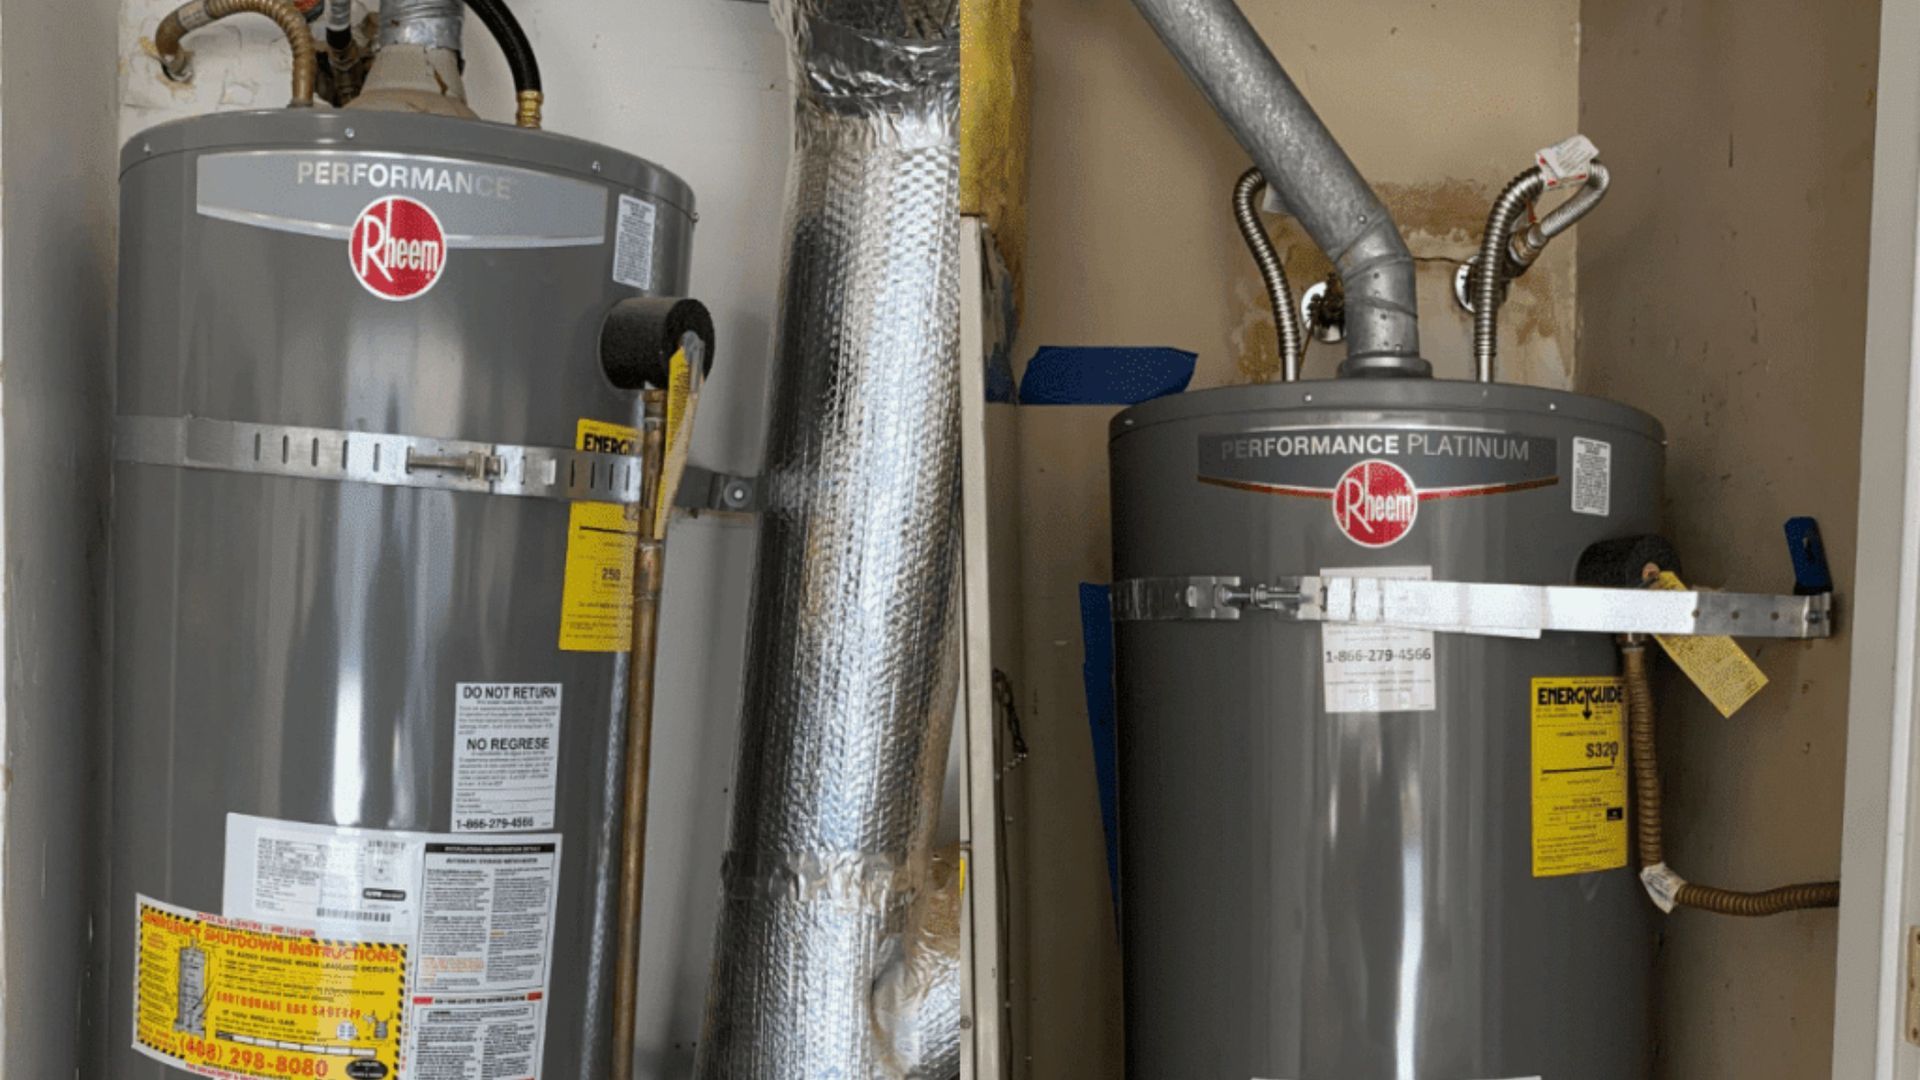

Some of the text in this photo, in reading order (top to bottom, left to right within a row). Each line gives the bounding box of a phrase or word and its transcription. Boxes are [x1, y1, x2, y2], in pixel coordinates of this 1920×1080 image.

[297, 161, 512, 200] PERFORMANCE
[359, 199, 439, 282] Rheem
[1221, 434, 1529, 461] PERFORMANCE PLATINUM
[1342, 464, 1413, 533] Rheem
[463, 685, 557, 699] DO NOT RETURN
[1538, 686, 1624, 705] ENERGYGUIDE
[466, 737, 550, 751] NO REGRESE
[205, 928, 284, 953] SHUTDOWN
[289, 941, 399, 963] INSTRUCTIONS
[229, 1046, 329, 1078] 298-8080
